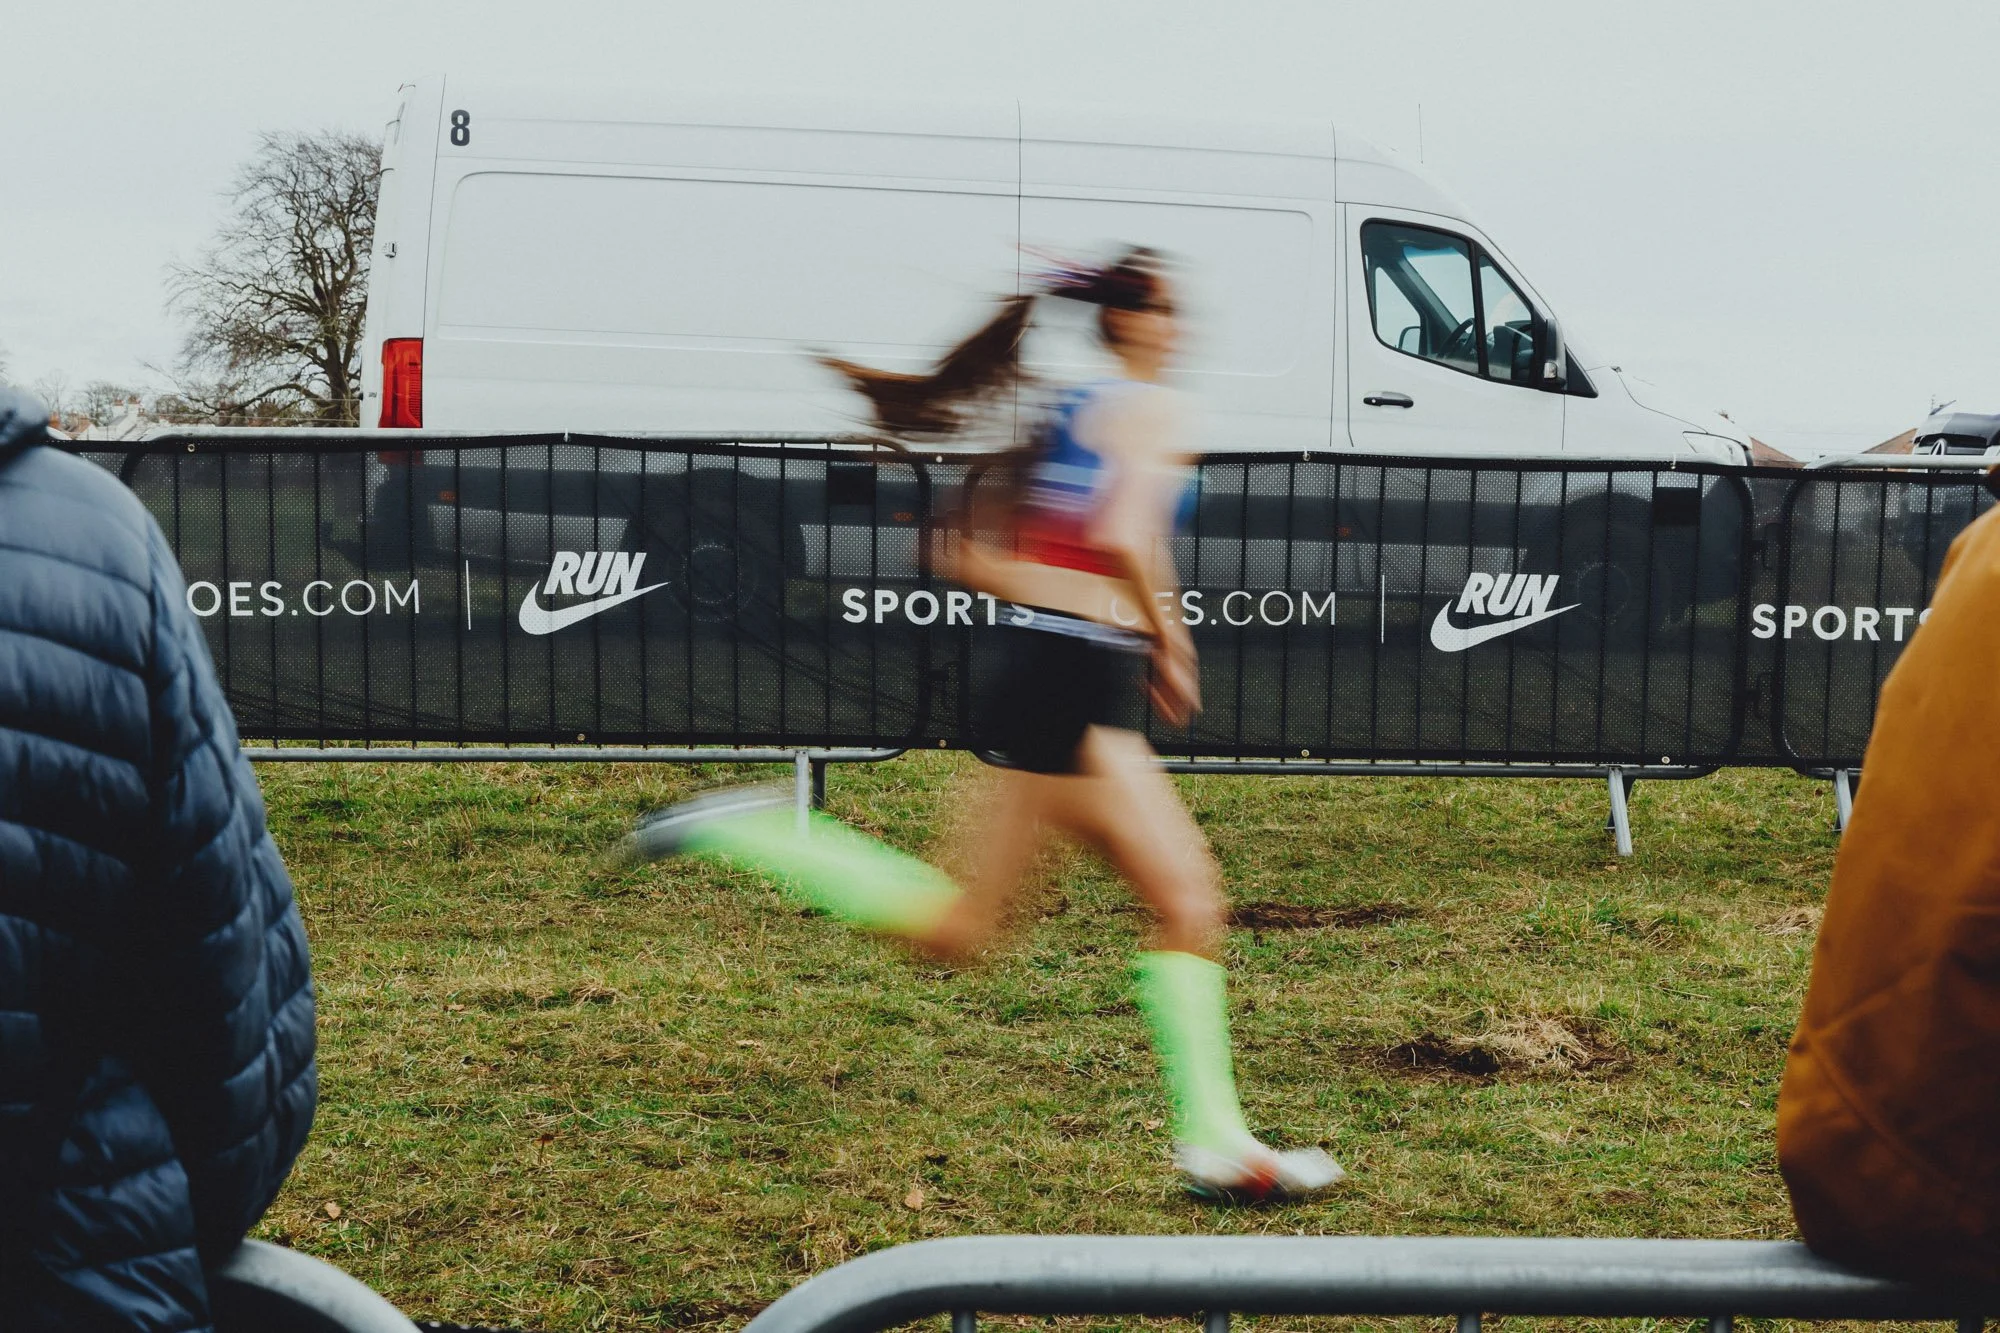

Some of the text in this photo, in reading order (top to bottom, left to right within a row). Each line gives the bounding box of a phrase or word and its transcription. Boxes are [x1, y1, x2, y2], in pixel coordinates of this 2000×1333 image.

[451, 109, 470, 146] 8
[543, 551, 648, 595] RUN
[186, 579, 420, 617] OES.COM
[1455, 572, 1560, 616] RUN
[1751, 603, 1934, 642] SPORT
